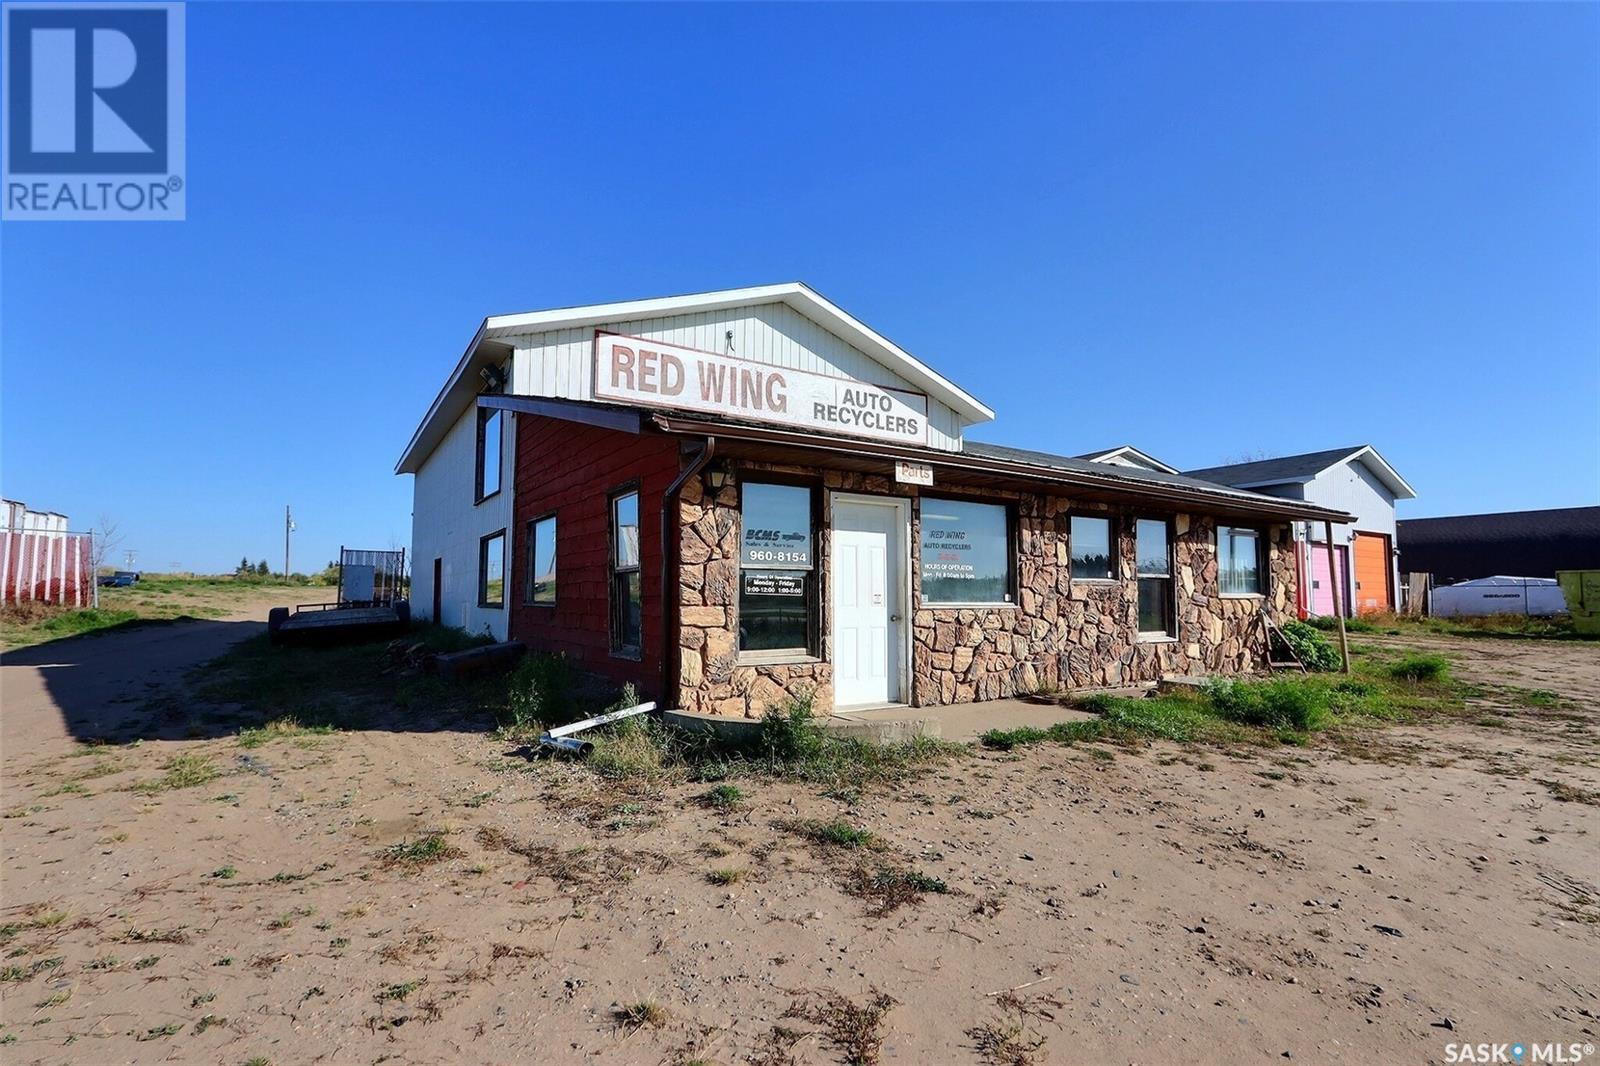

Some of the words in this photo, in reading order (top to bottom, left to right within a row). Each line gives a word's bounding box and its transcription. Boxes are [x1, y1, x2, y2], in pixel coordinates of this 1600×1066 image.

[610, 344, 686, 397] RED
[697, 360, 788, 413] WING
[842, 388, 893, 412] AUTO
[813, 402, 918, 435] RECYCLERS
[901, 463, 930, 479] Parts
[745, 529, 780, 541] BCMS
[929, 530, 945, 539] RED
[945, 531, 966, 540] WING
[749, 550, 806, 562] 960-8154
